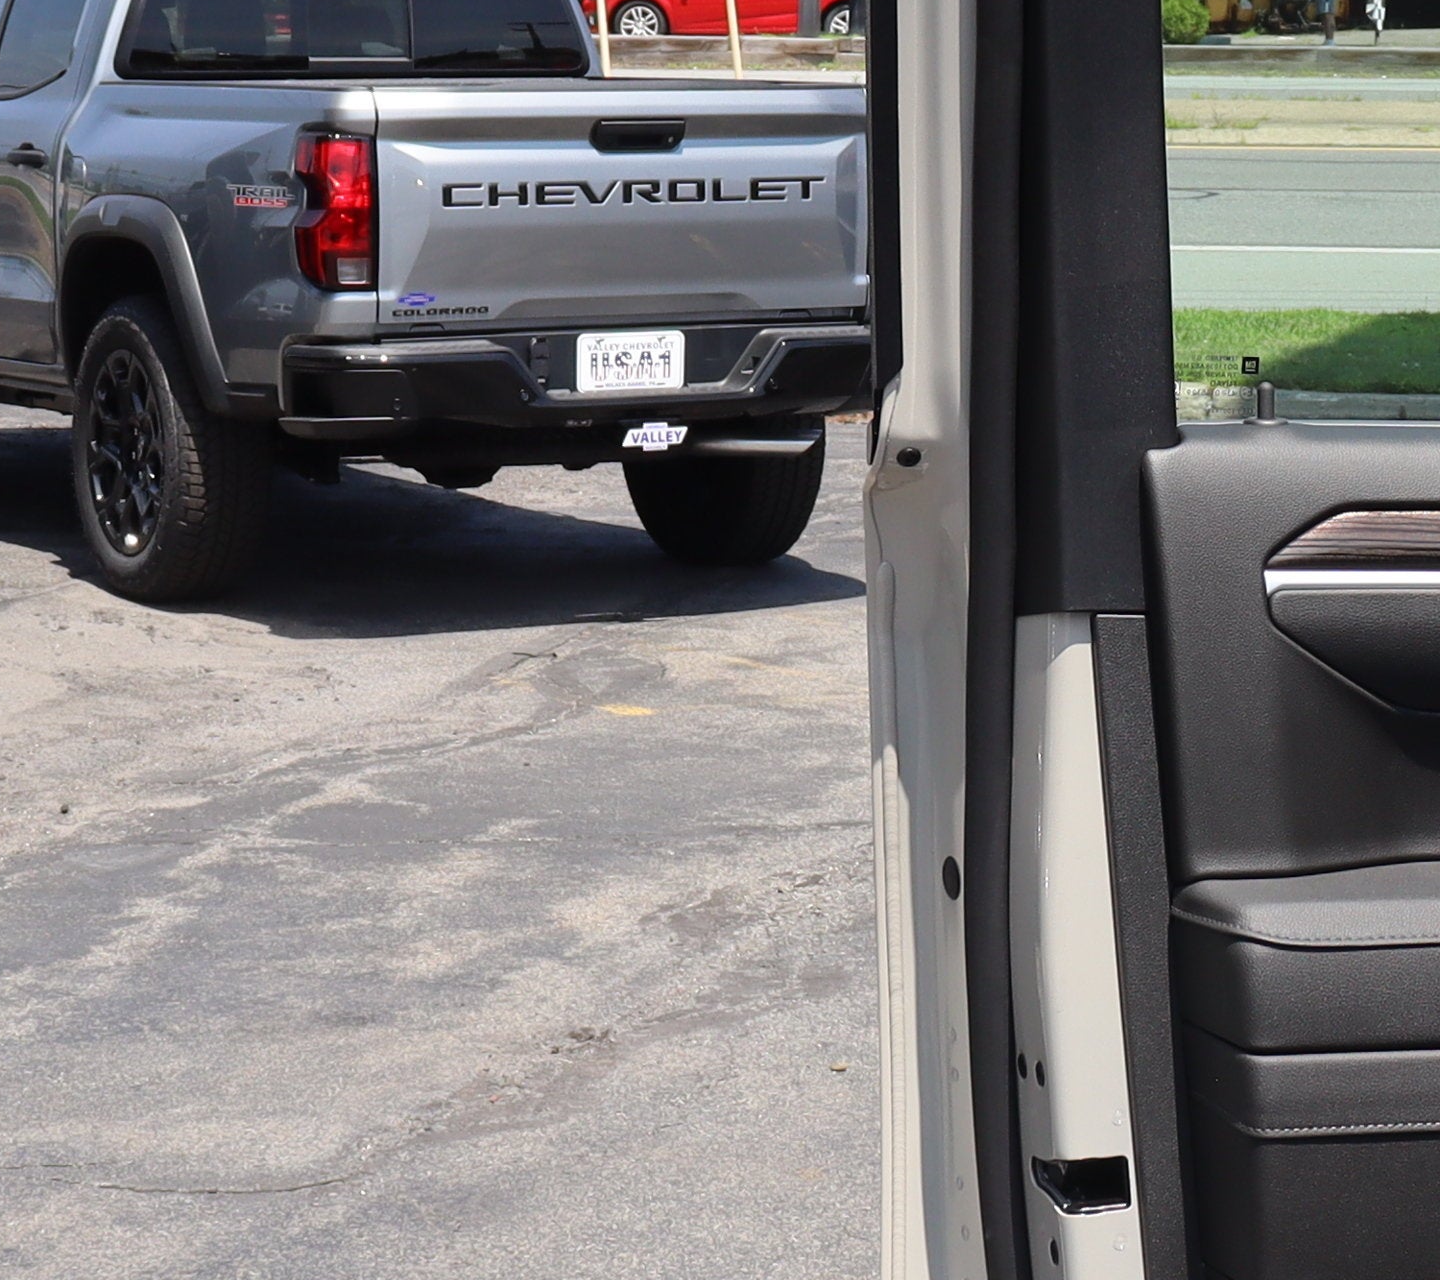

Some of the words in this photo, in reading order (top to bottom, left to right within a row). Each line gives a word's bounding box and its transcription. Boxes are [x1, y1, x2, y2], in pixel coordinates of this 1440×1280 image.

[226, 184, 295, 199] TRAIL
[441, 176, 826, 208] CHEVROLET
[234, 196, 288, 208] BOSS
[392, 306, 489, 317] COLORADO
[587, 342, 620, 352] VALLEY
[623, 341, 674, 350] CHEVROLET
[631, 430, 682, 444] VALLEY
